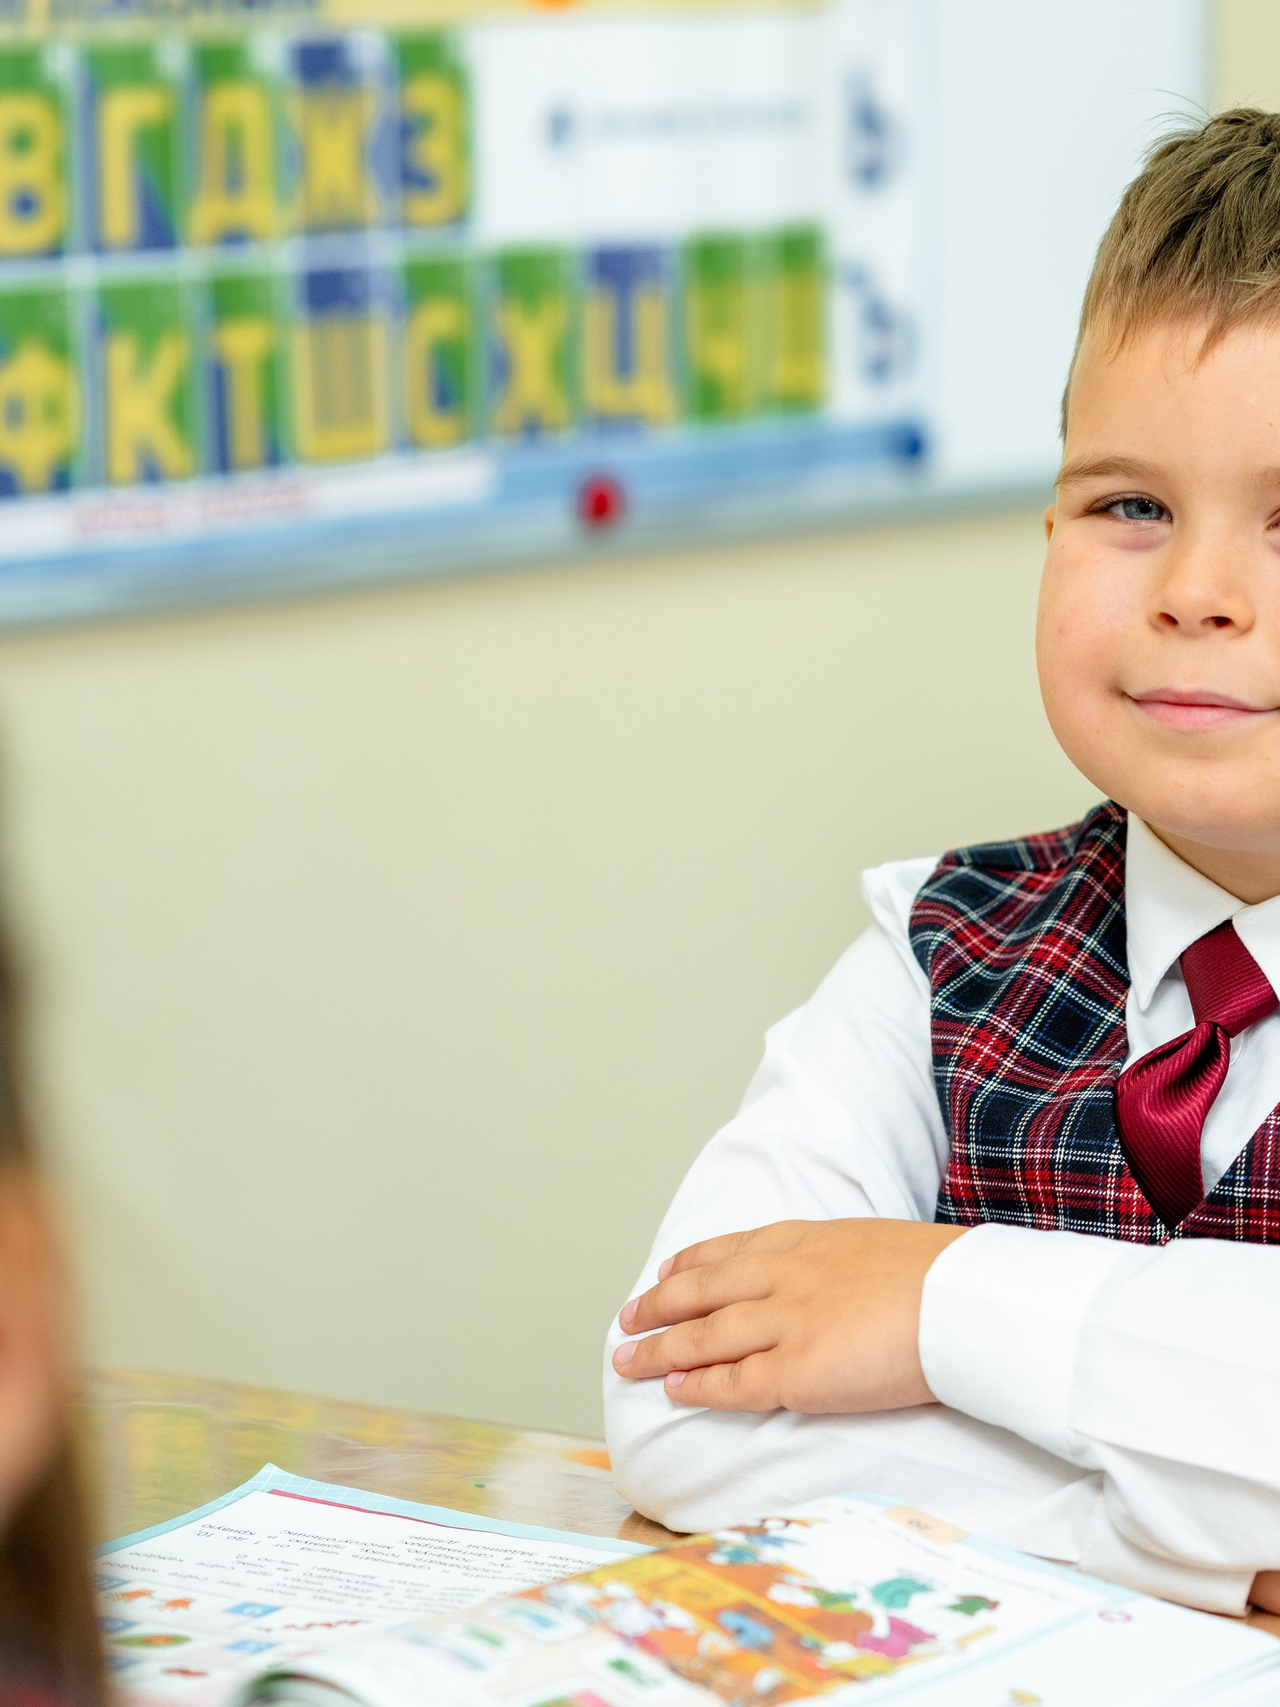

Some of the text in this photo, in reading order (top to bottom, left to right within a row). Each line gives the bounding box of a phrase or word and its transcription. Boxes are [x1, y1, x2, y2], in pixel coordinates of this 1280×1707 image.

[102, 87, 170, 248] Г
[187, 80, 277, 246] Д
[400, 72, 469, 228] З
[105, 332, 194, 487] К
[210, 318, 272, 470] Т
[407, 300, 467, 448] С
[492, 303, 568, 436] Х
[584, 284, 677, 428] Ц
[202, 1524, 256, 1535] кривую
[289, 1539, 345, 1549] прямую
[300, 1547, 339, 1555] числа
